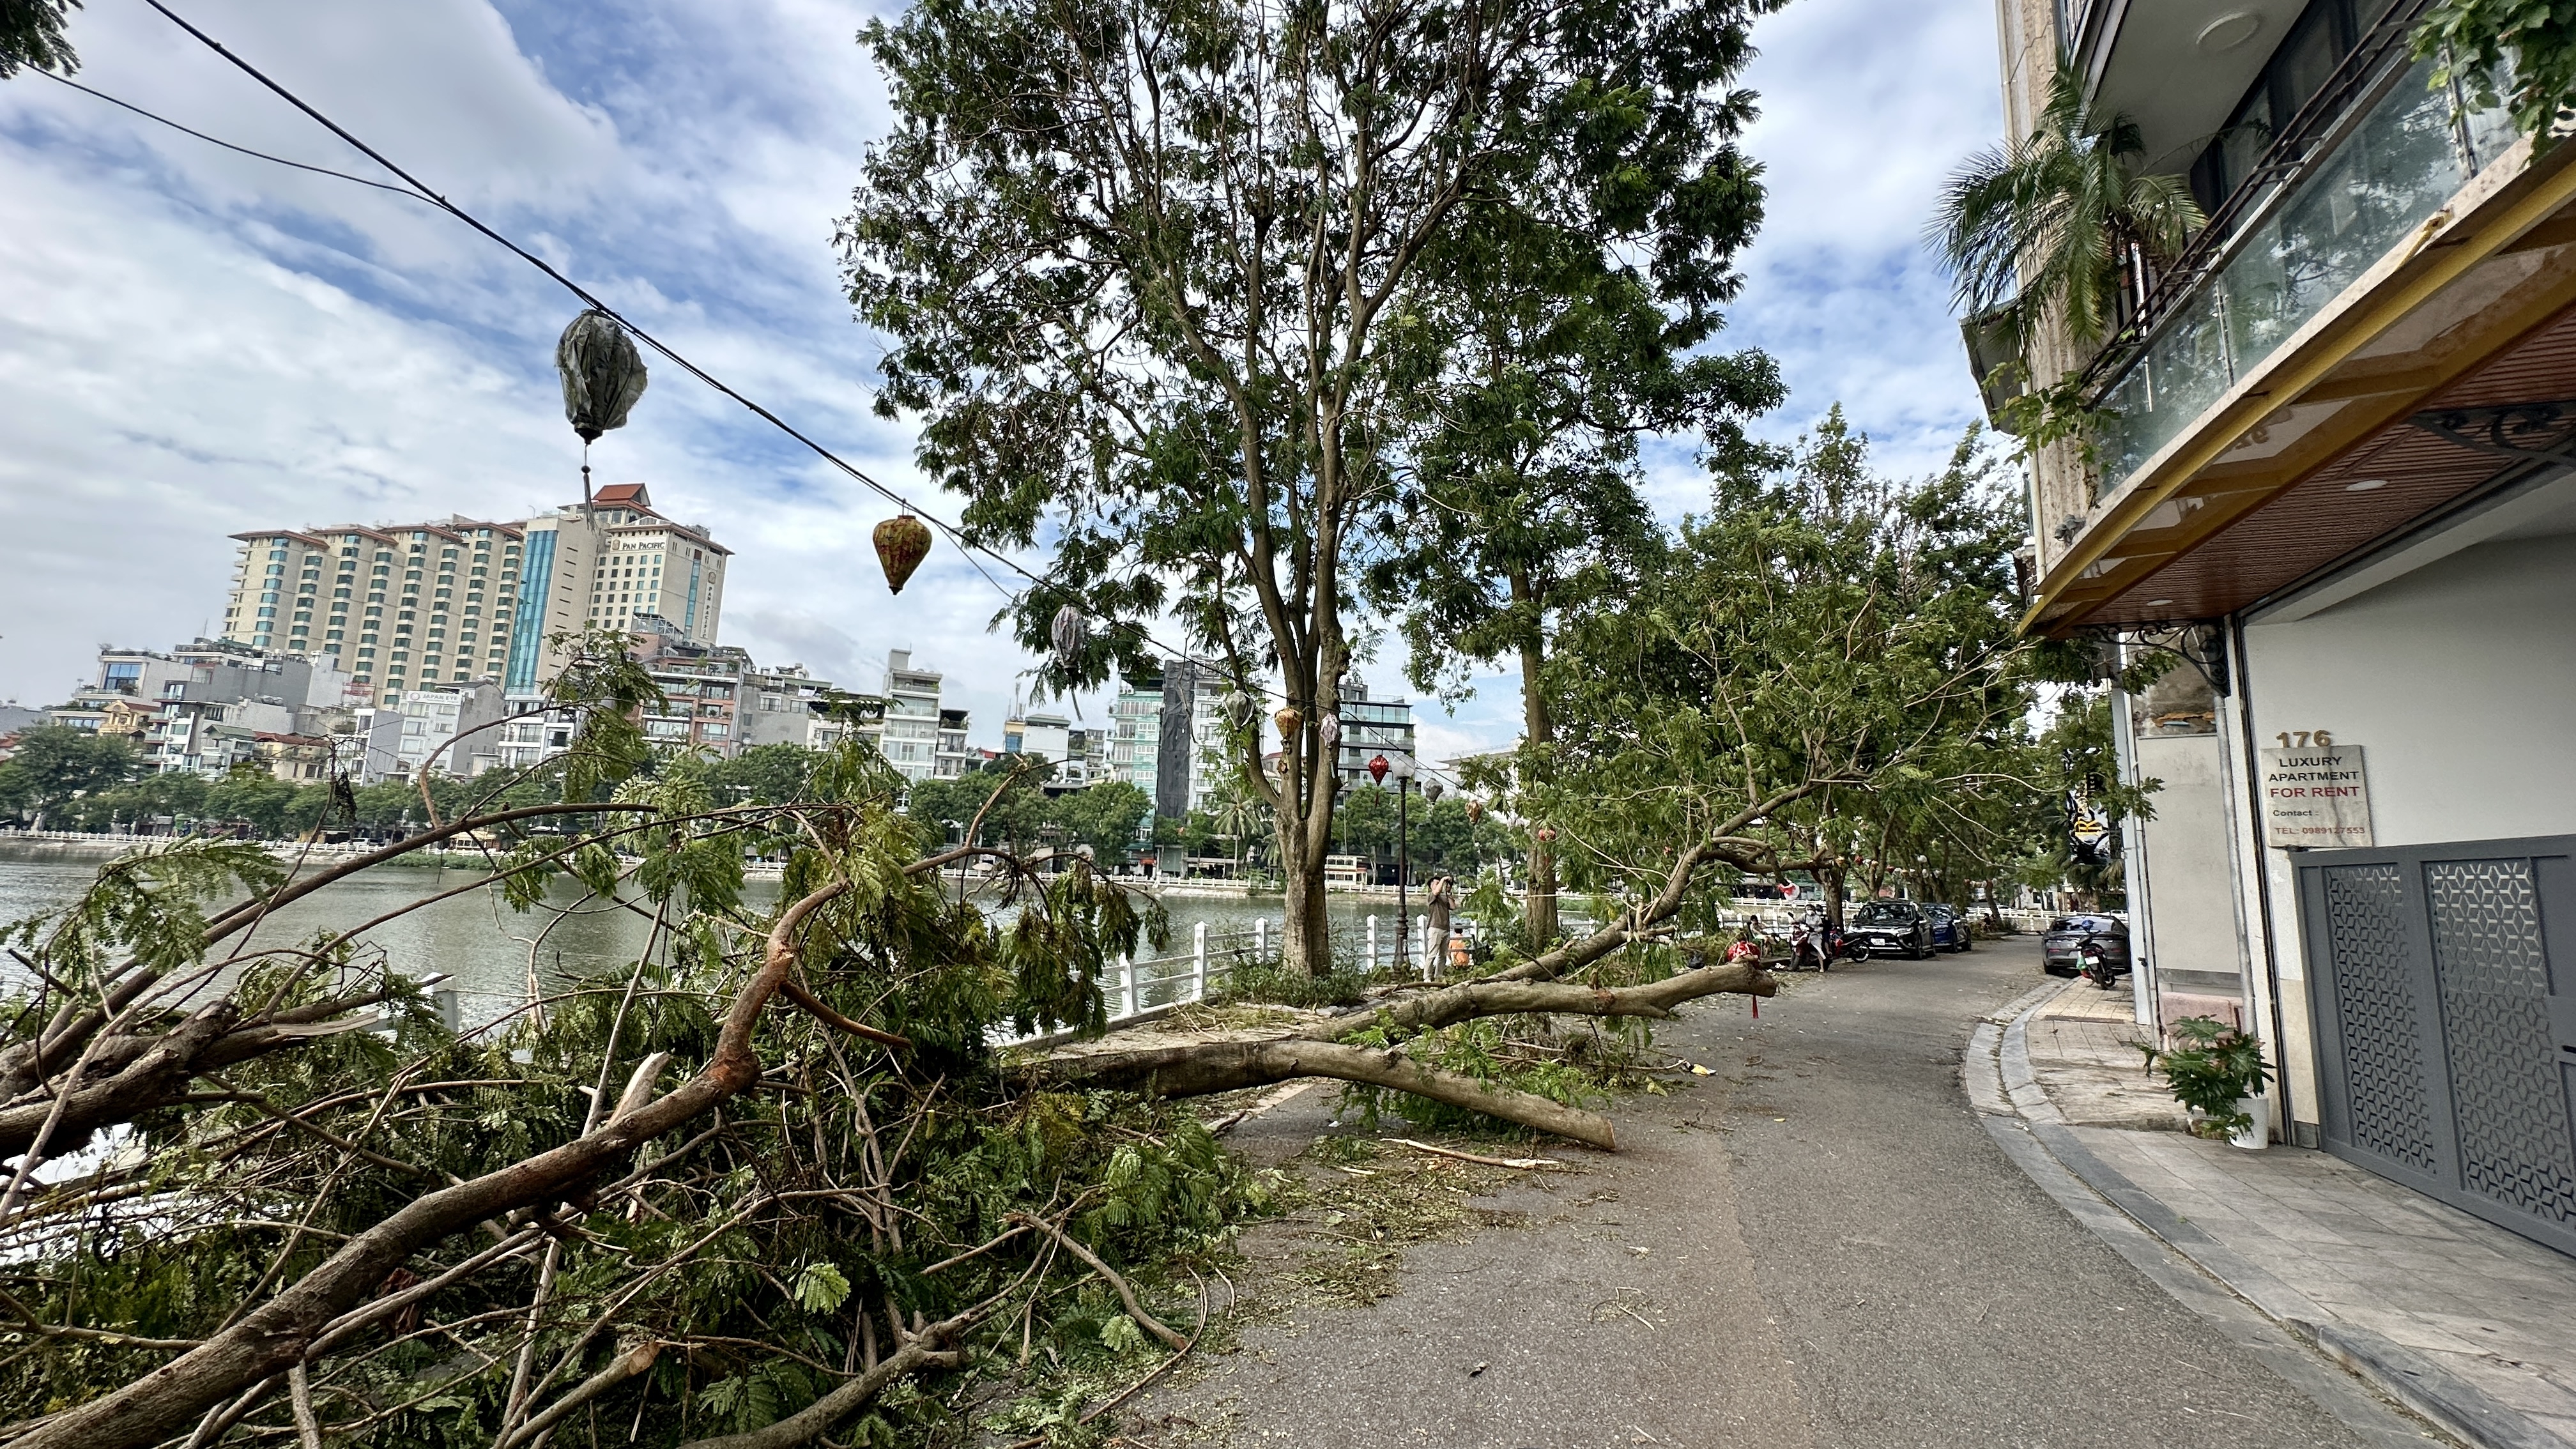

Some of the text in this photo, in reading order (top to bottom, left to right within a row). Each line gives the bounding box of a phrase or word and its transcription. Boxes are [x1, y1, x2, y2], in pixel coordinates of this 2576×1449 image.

[2276, 730, 2331, 748] 176
[2279, 756, 2342, 767] LUXURY
[2269, 771, 2359, 781] APARTMENT
[2270, 786, 2360, 799] FOR RENT
